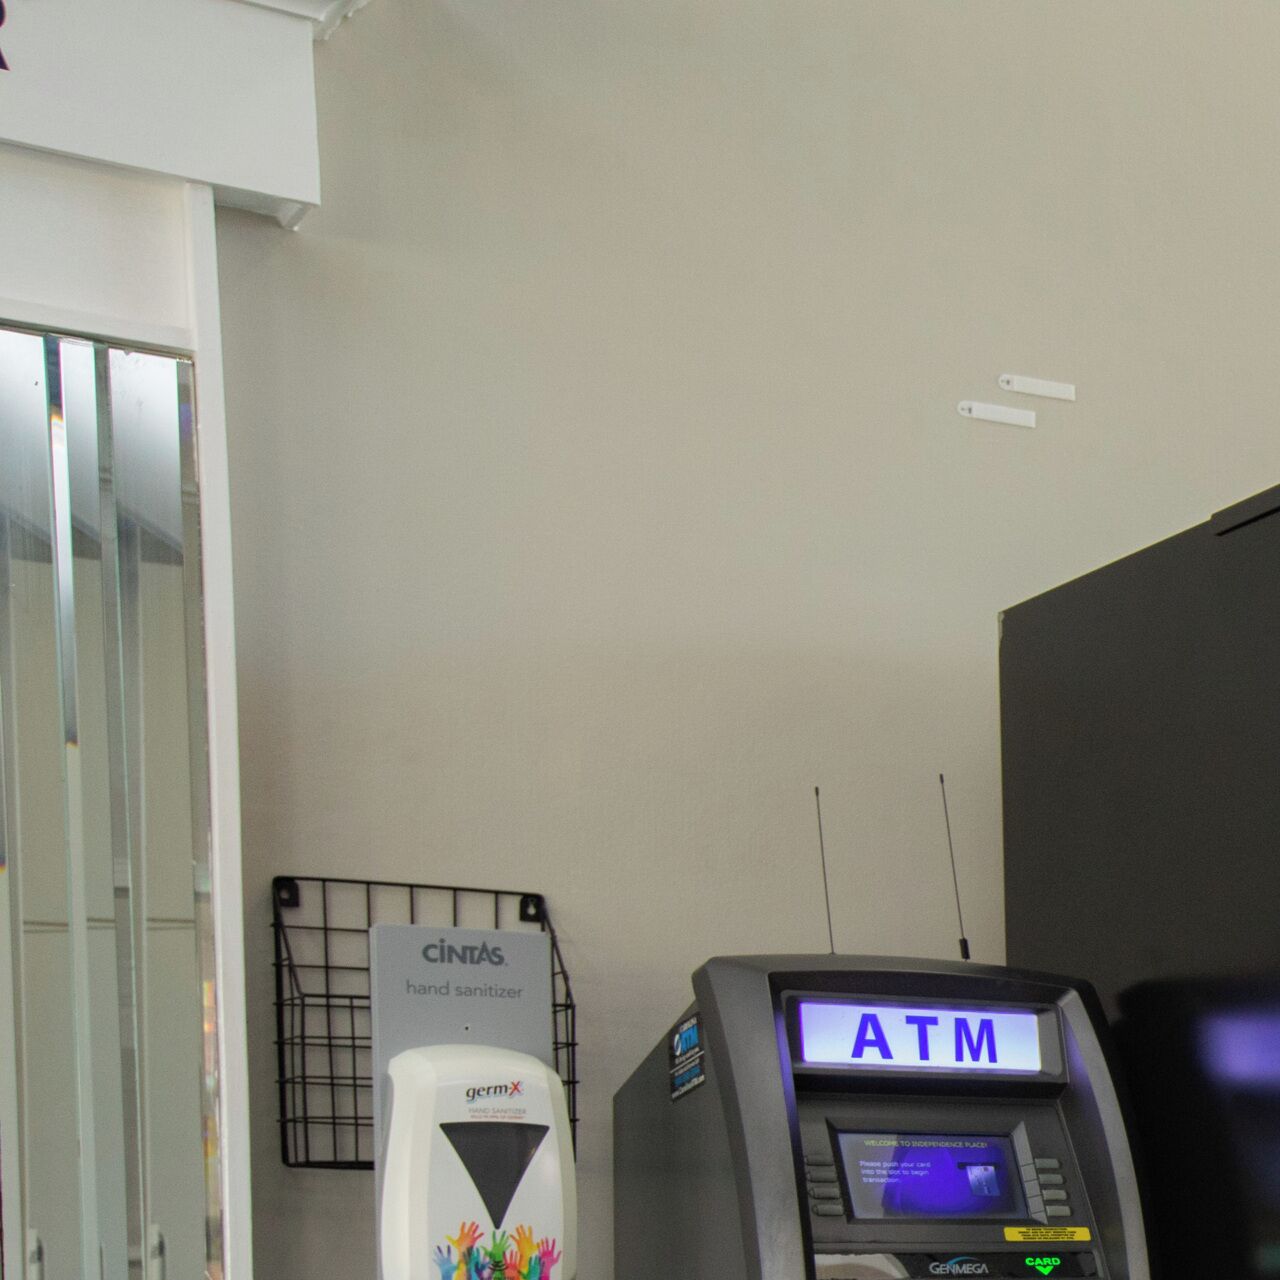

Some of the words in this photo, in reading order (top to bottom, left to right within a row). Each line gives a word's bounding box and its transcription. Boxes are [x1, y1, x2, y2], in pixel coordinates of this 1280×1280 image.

[406, 979, 450, 996] hand
[455, 983, 524, 999] sanitizer
[851, 1013, 998, 1064] ATM
[863, 1139, 899, 1147] WELCOME
[911, 1140, 965, 1148] INDEPENDENCE
[858, 1160, 881, 1168] Please
[900, 1161, 915, 1169] your
[916, 1160, 931, 1168] card
[1024, 1257, 1061, 1266] CARD
[928, 1261, 990, 1275] GENMEGA
